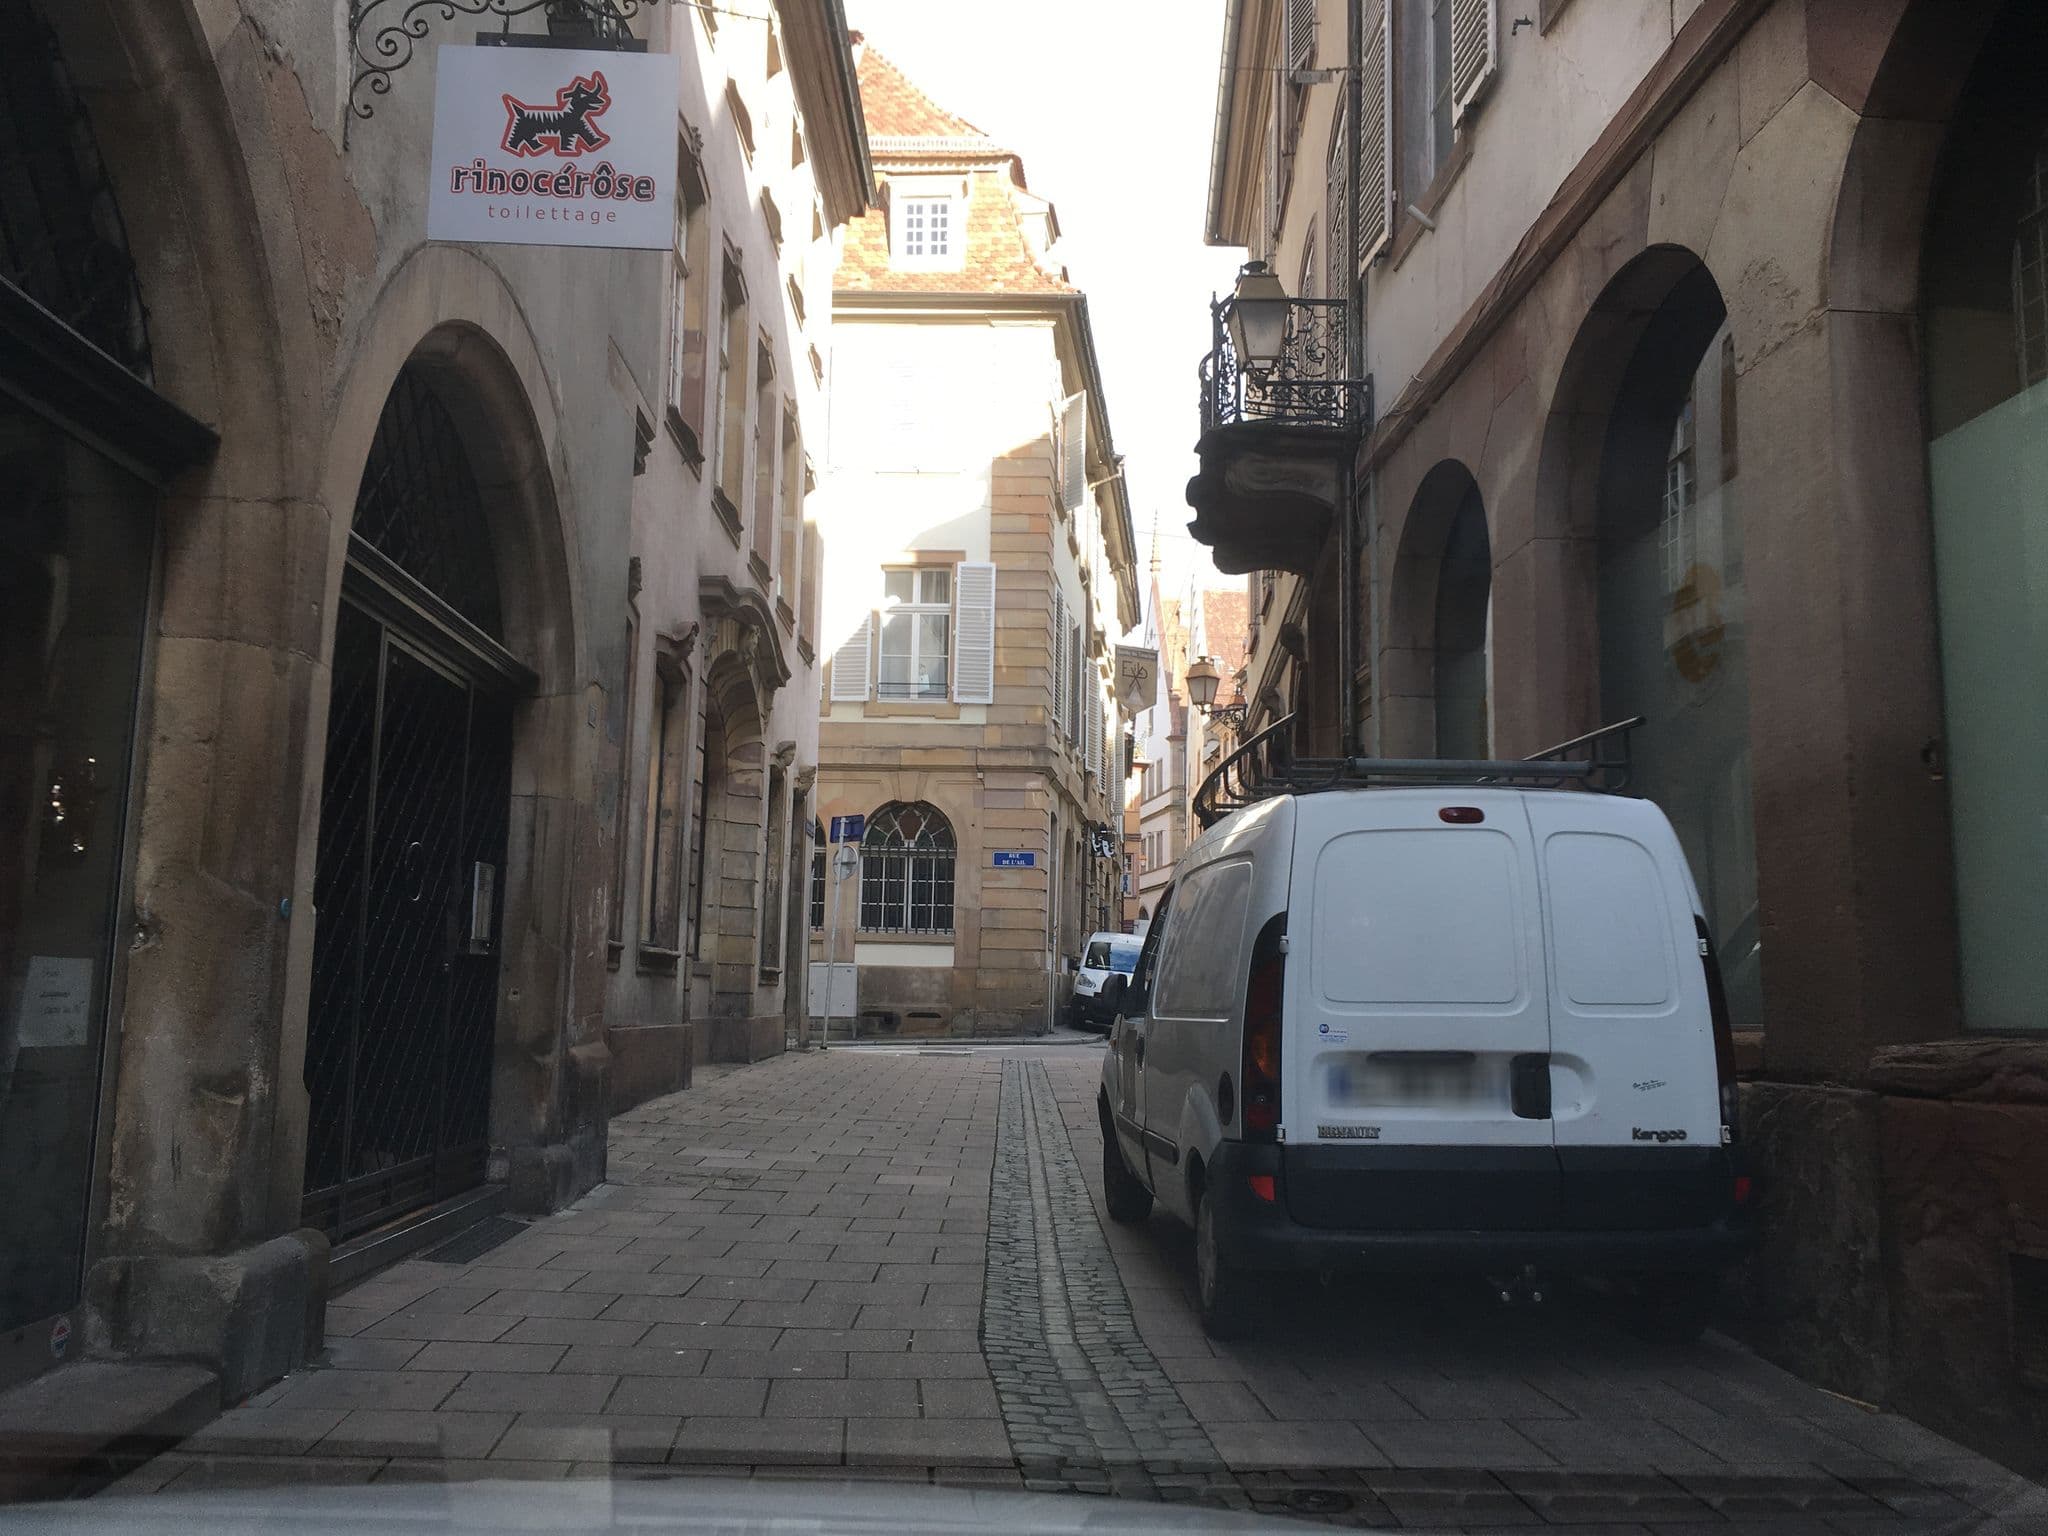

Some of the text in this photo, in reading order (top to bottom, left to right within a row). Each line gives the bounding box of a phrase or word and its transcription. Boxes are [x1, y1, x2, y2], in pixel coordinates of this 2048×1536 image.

[451, 159, 655, 201] rinocérôse
[488, 204, 616, 224] toilettage
[1317, 1126, 1380, 1139] RENAULT
[1632, 1127, 1687, 1143] Kangoo
